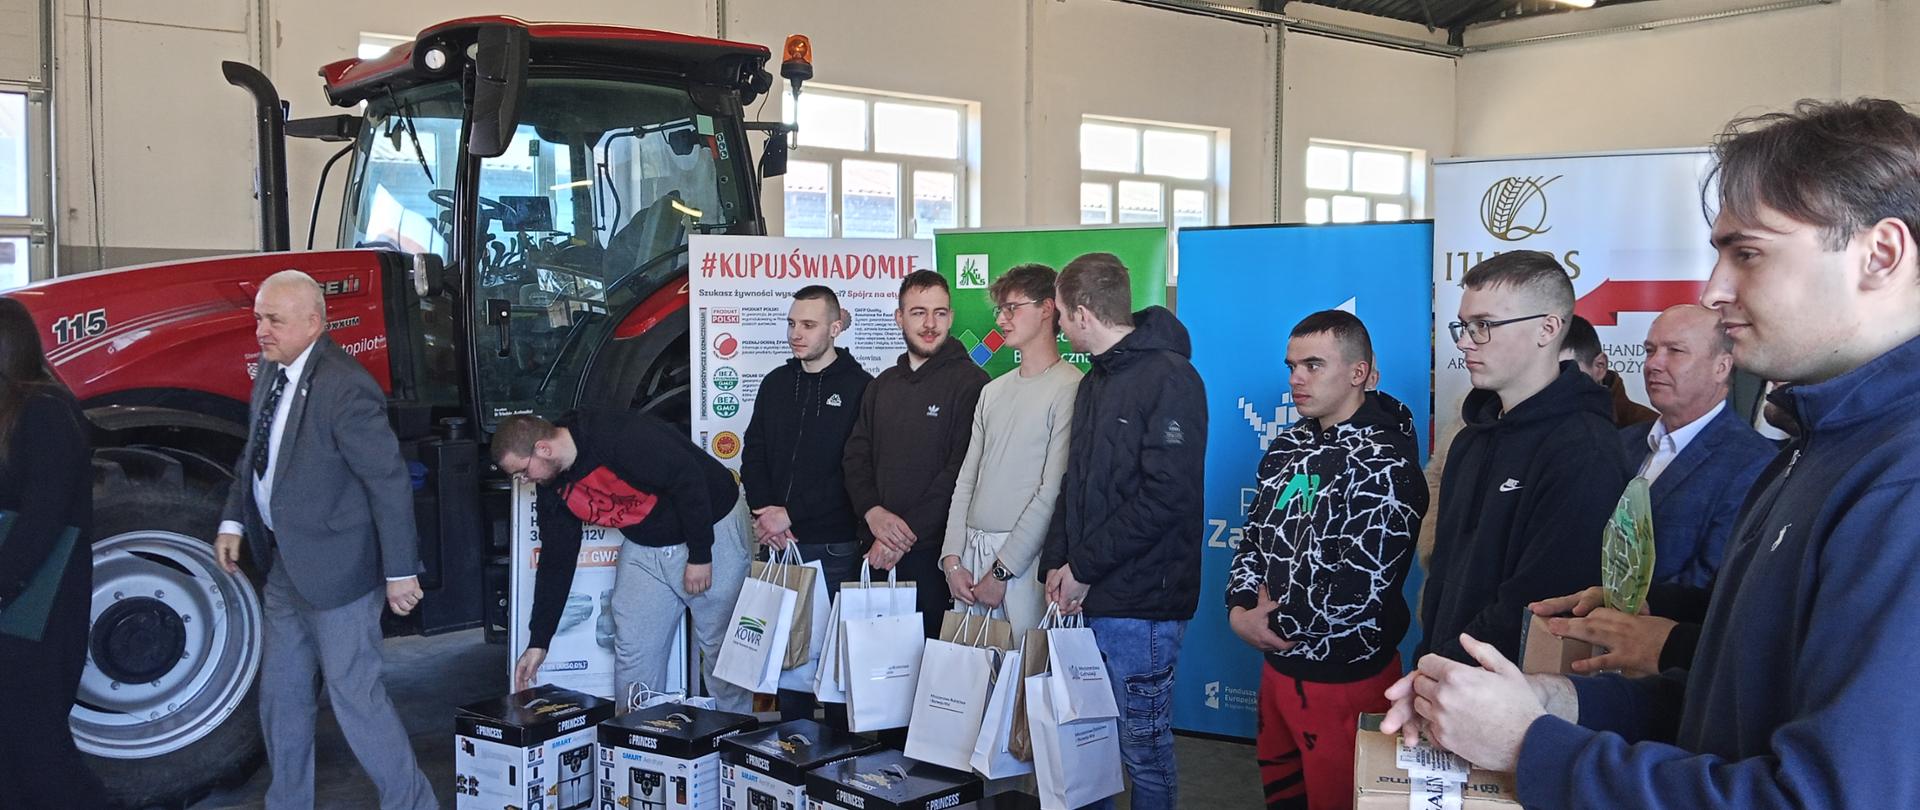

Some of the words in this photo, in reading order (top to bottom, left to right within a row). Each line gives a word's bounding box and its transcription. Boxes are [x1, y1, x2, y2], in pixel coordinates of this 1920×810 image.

[701, 248, 919, 280] #KUPUJŚWIADOMIE
[699, 289, 733, 297] Szukasz
[734, 289, 773, 299] żywności
[774, 290, 795, 299] wyso
[847, 290, 873, 300] Spójrz
[886, 291, 900, 300] ety
[52, 308, 107, 344] 115
[712, 315, 739, 323] POLSKI
[1602, 344, 1646, 356] HAND
[717, 396, 734, 404] BEZ
[591, 550, 617, 563] GWA
[734, 626, 762, 646] KOWR
[561, 714, 588, 730] PRINCESS
[478, 725, 503, 739] PRINCESS
[631, 733, 658, 750] PRINCESS
[622, 752, 643, 762] SMART
[748, 754, 771, 772] PRINCESS
[741, 771, 760, 783] SMART
[838, 790, 866, 809] PRINCESS
[928, 792, 962, 810] PRINCESS
